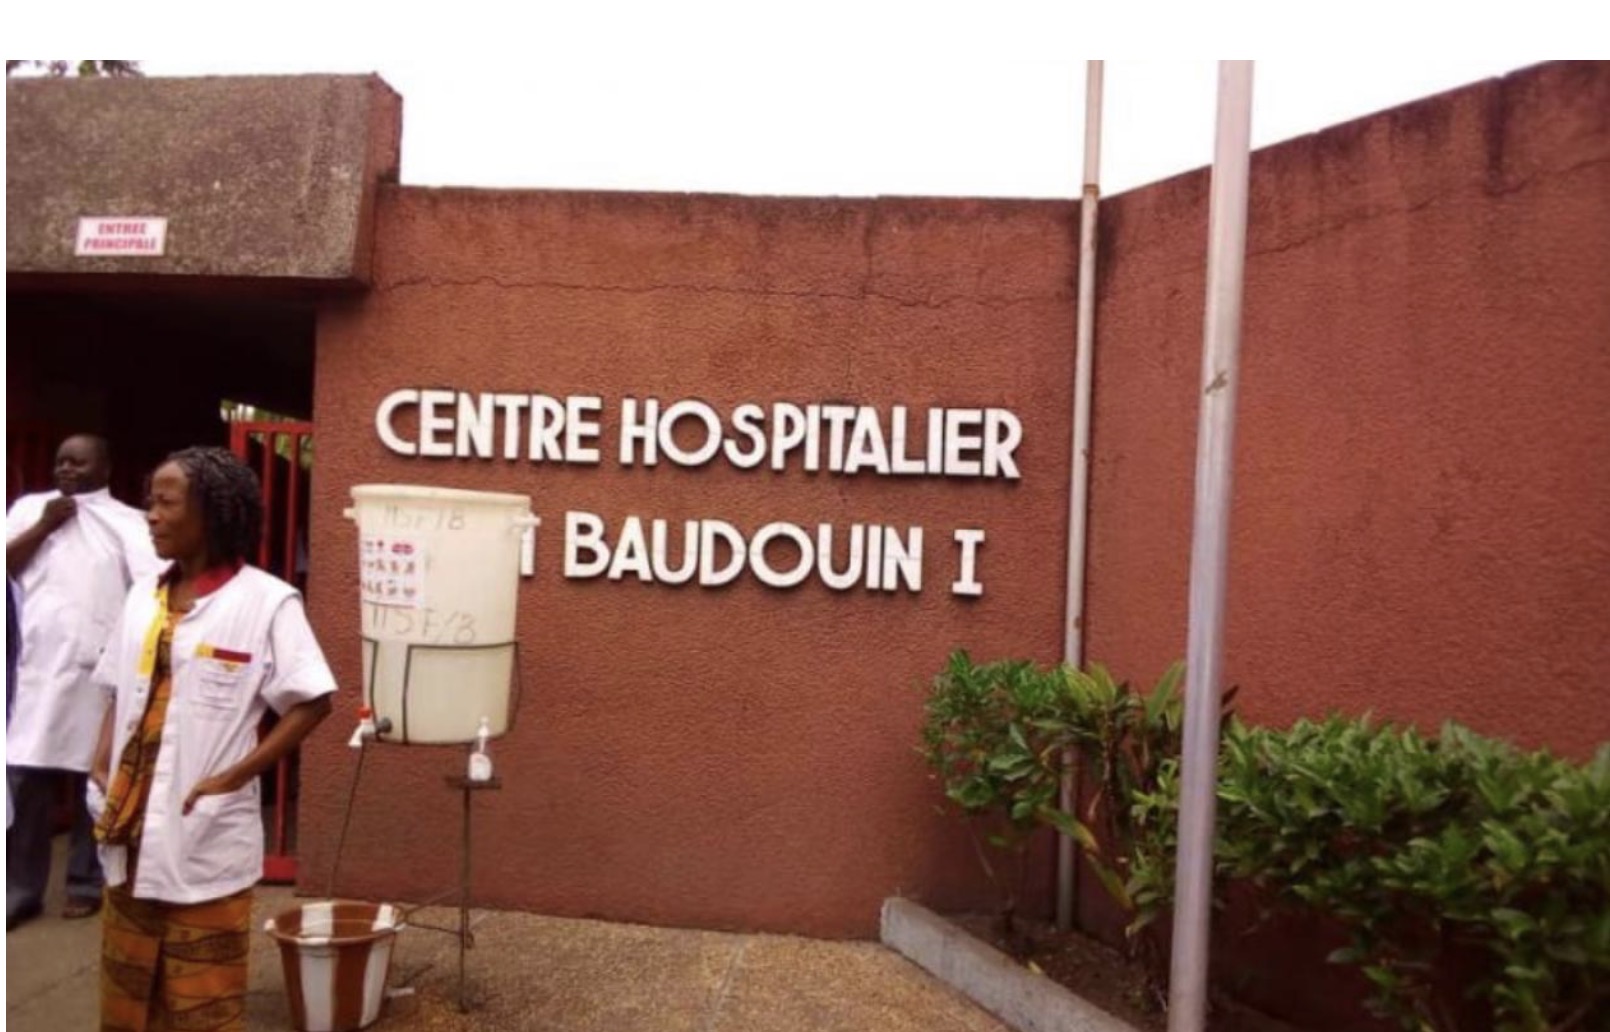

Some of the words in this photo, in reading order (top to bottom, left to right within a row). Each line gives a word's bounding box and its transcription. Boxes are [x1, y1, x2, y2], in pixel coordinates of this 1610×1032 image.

[84, 238, 156, 250] PRINCIPALE
[376, 390, 601, 463] CENTRE
[619, 398, 1022, 478] HOSPITALIER
[564, 510, 923, 592] BAUDOUIN
[951, 528, 985, 596] I
